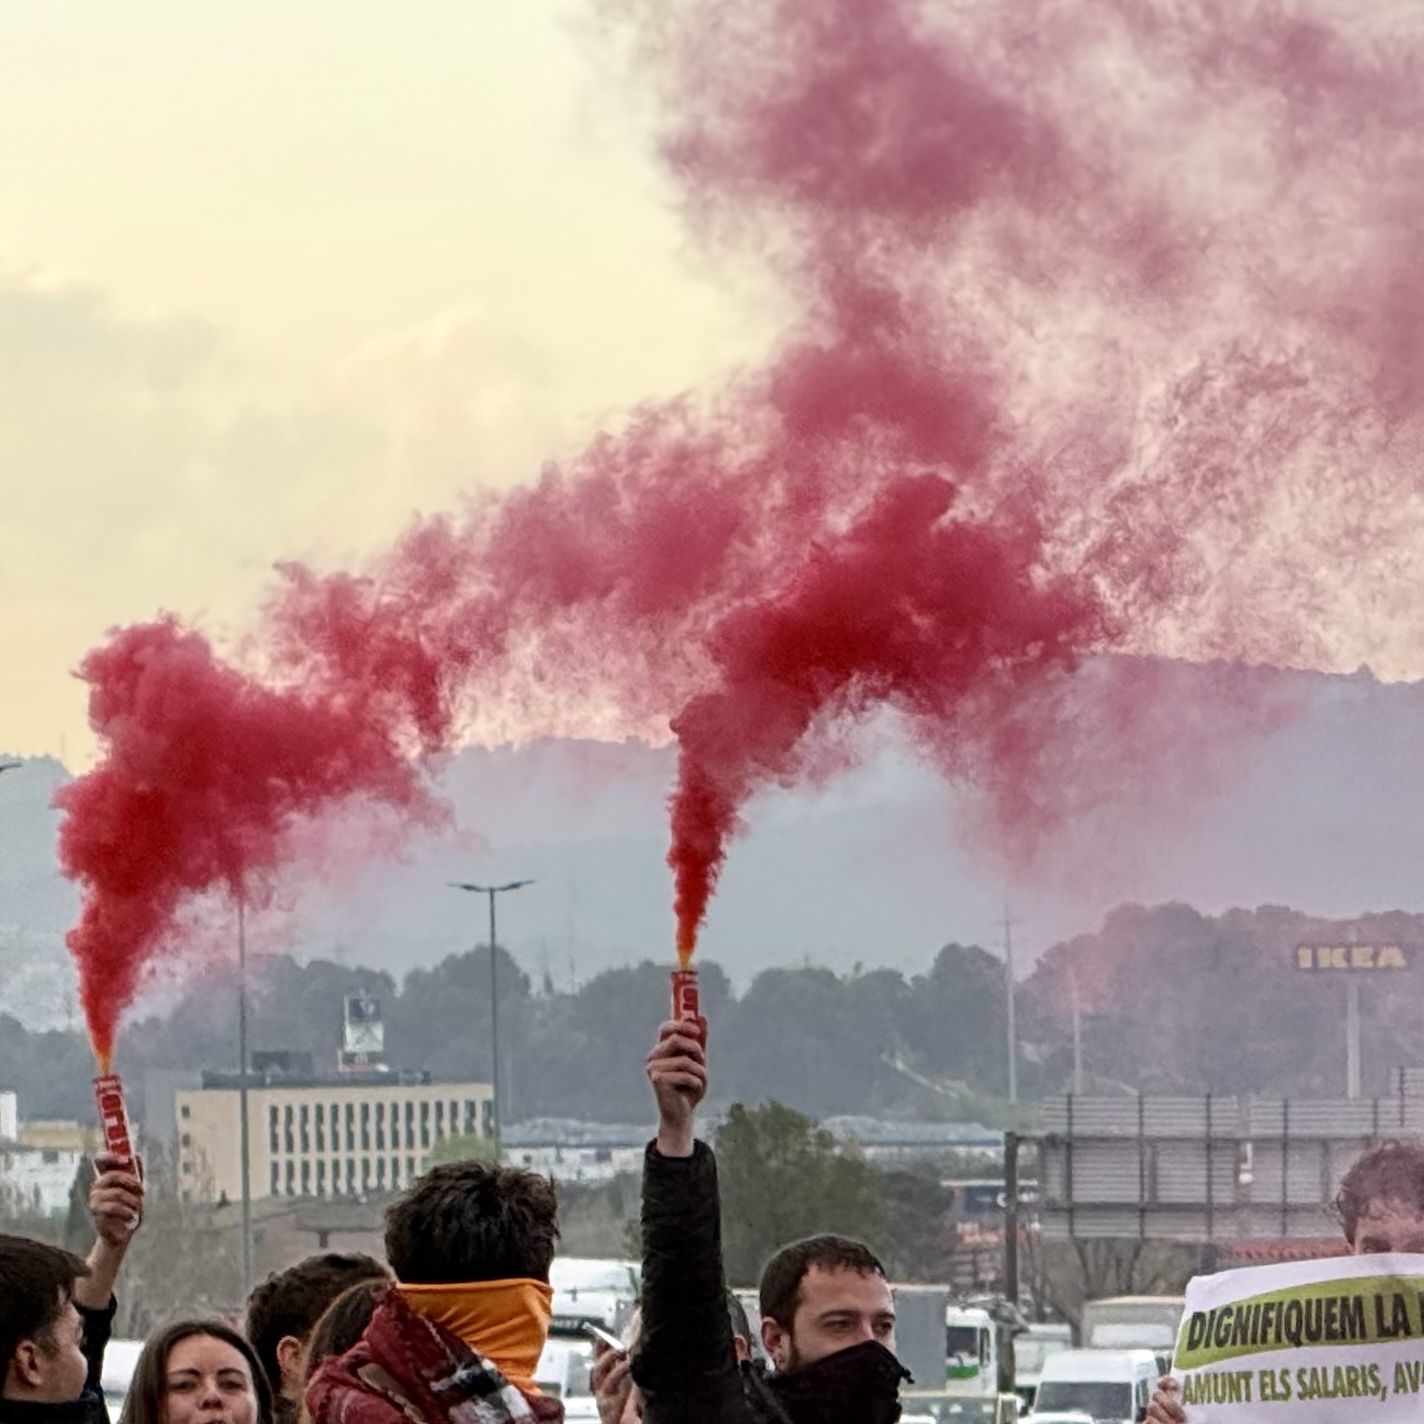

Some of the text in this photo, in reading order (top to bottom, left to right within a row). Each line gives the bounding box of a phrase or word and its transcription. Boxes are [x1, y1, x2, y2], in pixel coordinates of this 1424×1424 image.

[1297, 945, 1407, 968] IKEA
[1186, 1294, 1367, 1350] DIGNIFIQUEM
[1374, 1292, 1412, 1339] LA
[1182, 1370, 1253, 1406] AMUNT
[1259, 1368, 1292, 1402] ELS
[1298, 1367, 1387, 1402] SALARIS,
